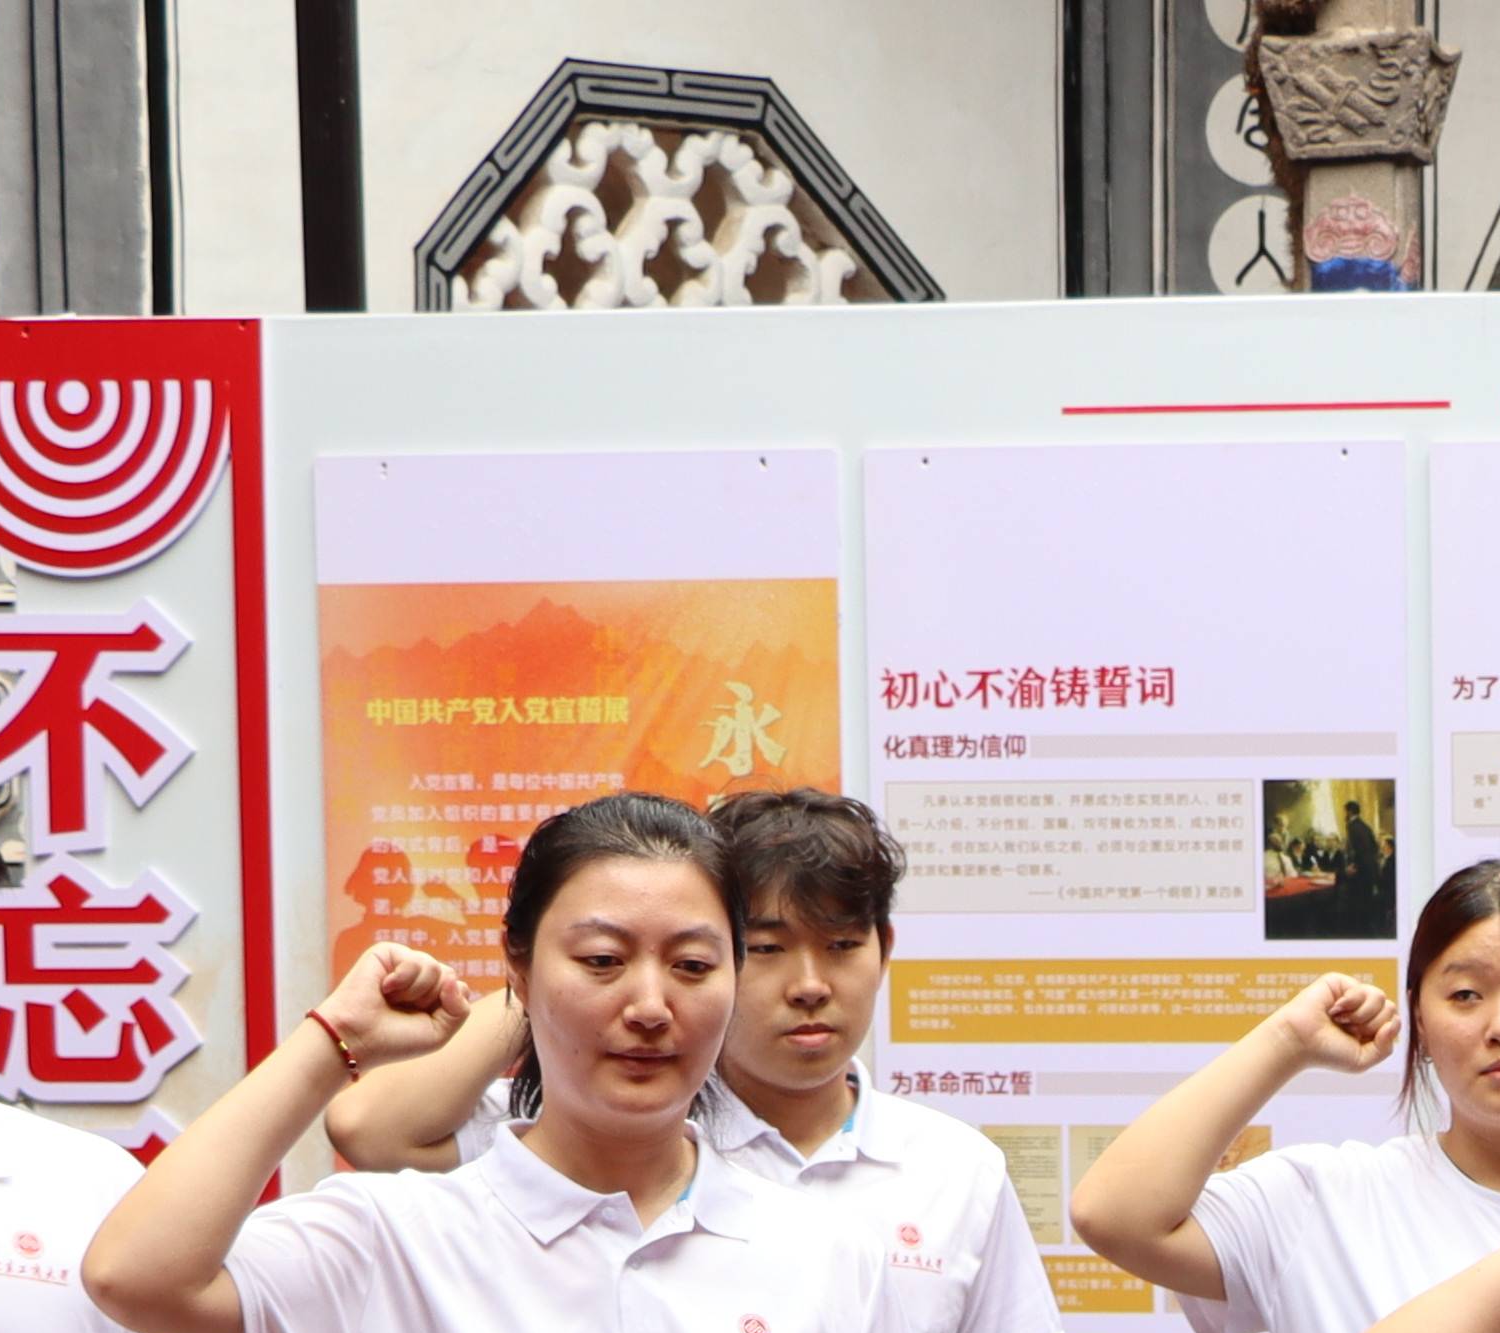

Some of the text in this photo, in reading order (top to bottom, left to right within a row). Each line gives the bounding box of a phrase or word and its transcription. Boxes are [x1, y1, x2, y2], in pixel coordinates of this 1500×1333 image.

[879, 664, 1177, 711] 初心不渝铸誓词
[366, 695, 629, 726] 中国共产党入党宣誓展
[698, 678, 790, 808] 永
[882, 732, 1028, 761] 化真理为信仰
[890, 1069, 1033, 1097] 为革命而立誓
